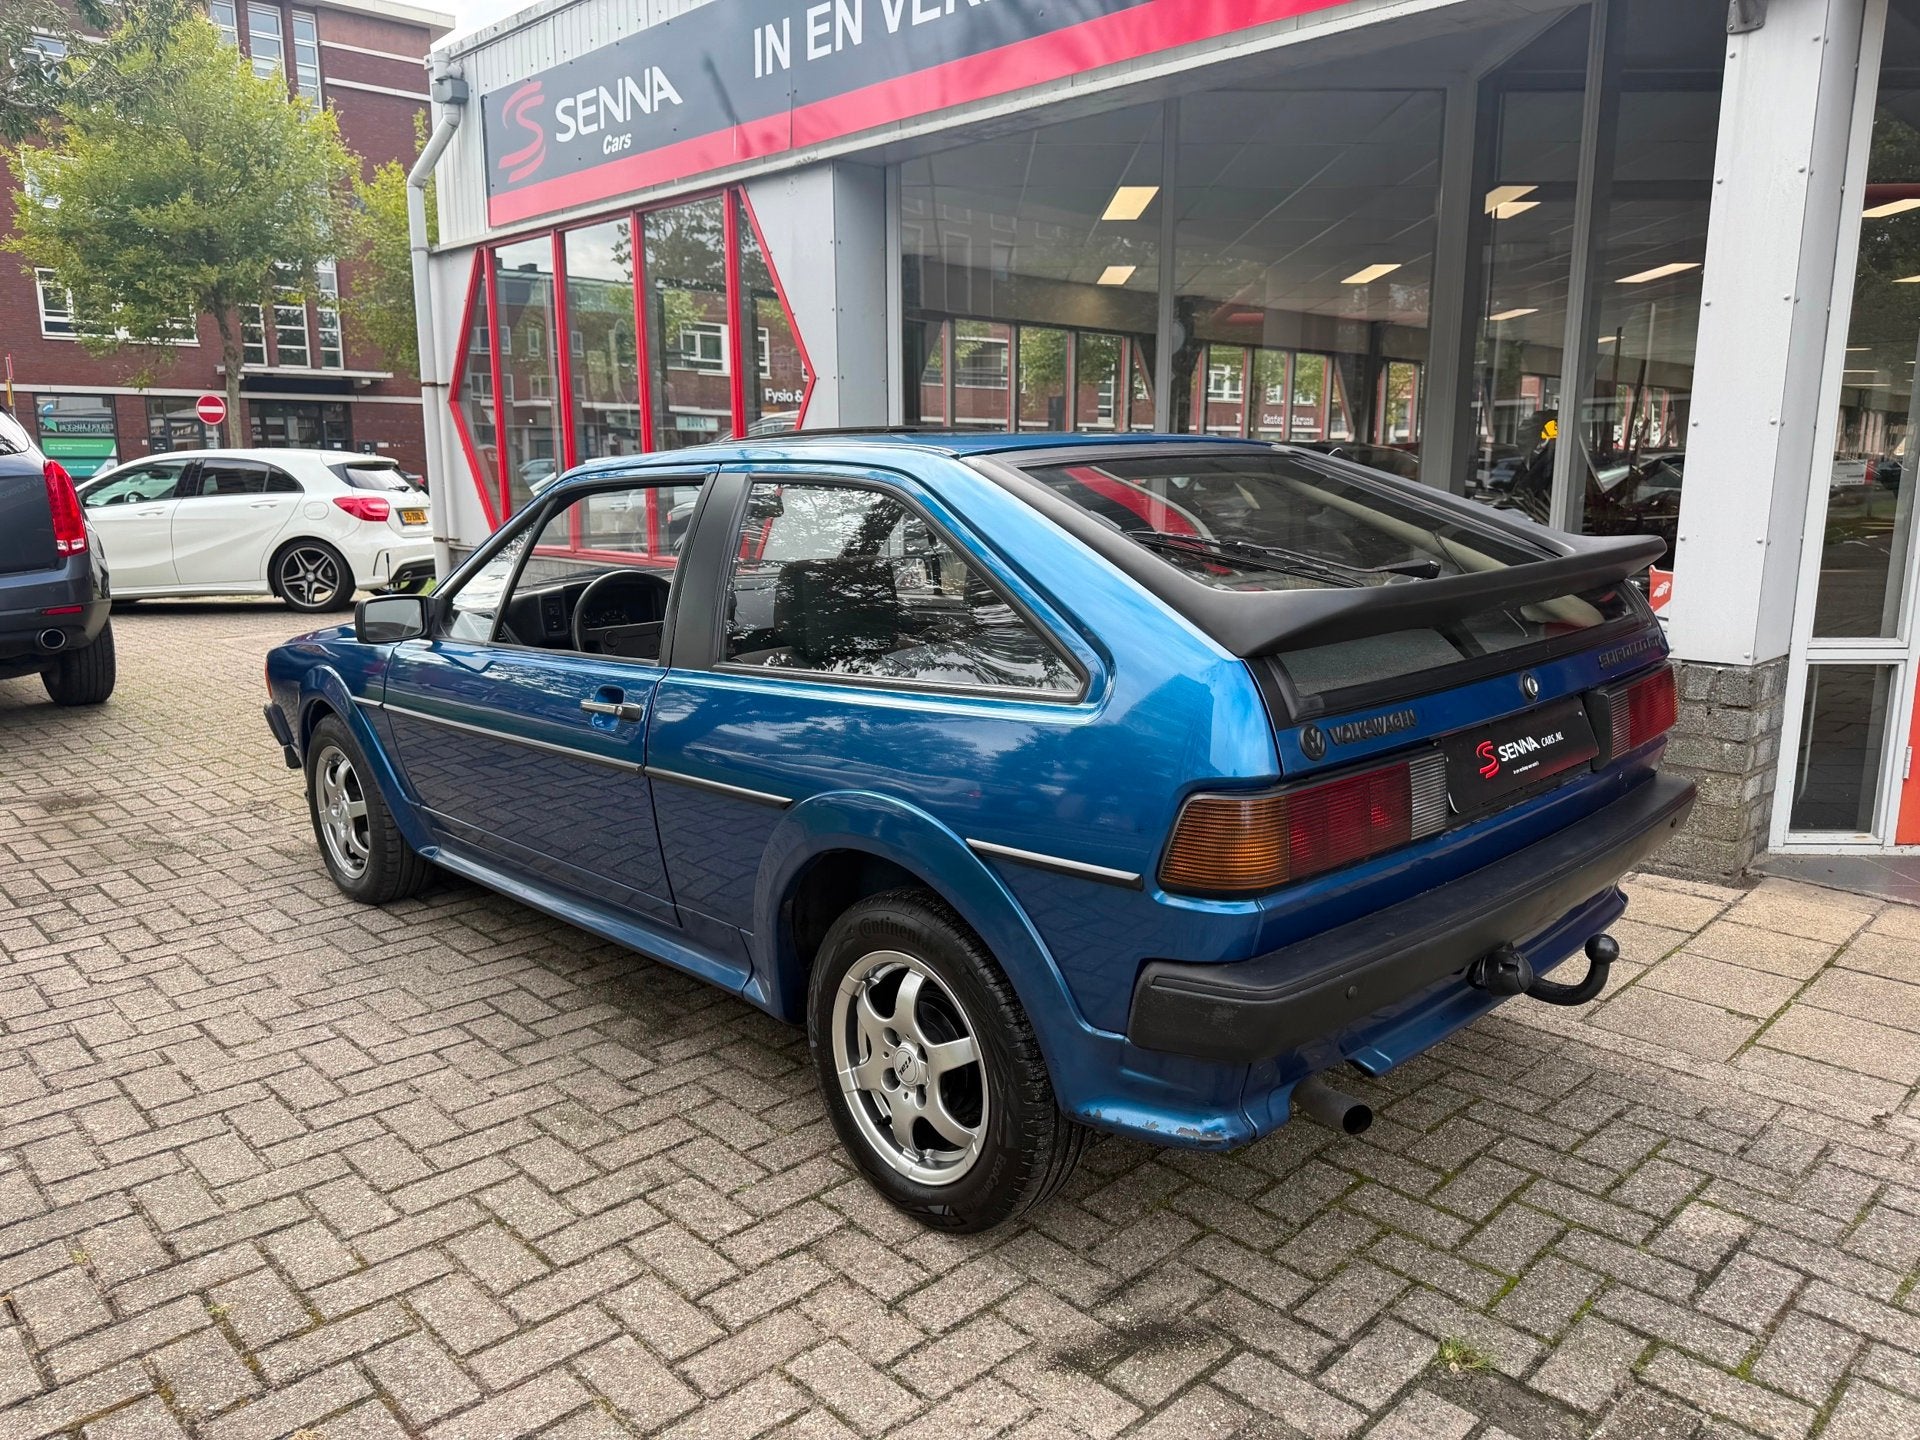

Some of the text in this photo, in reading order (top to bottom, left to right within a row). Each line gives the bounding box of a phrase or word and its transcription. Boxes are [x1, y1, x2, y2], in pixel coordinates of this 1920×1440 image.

[754, 17, 790, 78] IN
[806, 0, 863, 61] EN
[555, 66, 684, 143] SENNA
[602, 132, 632, 155] Cars
[764, 388, 793, 404] Fysio
[1327, 709, 1417, 746] VOLKSWAGEN
[1497, 736, 1541, 762] SENNA
